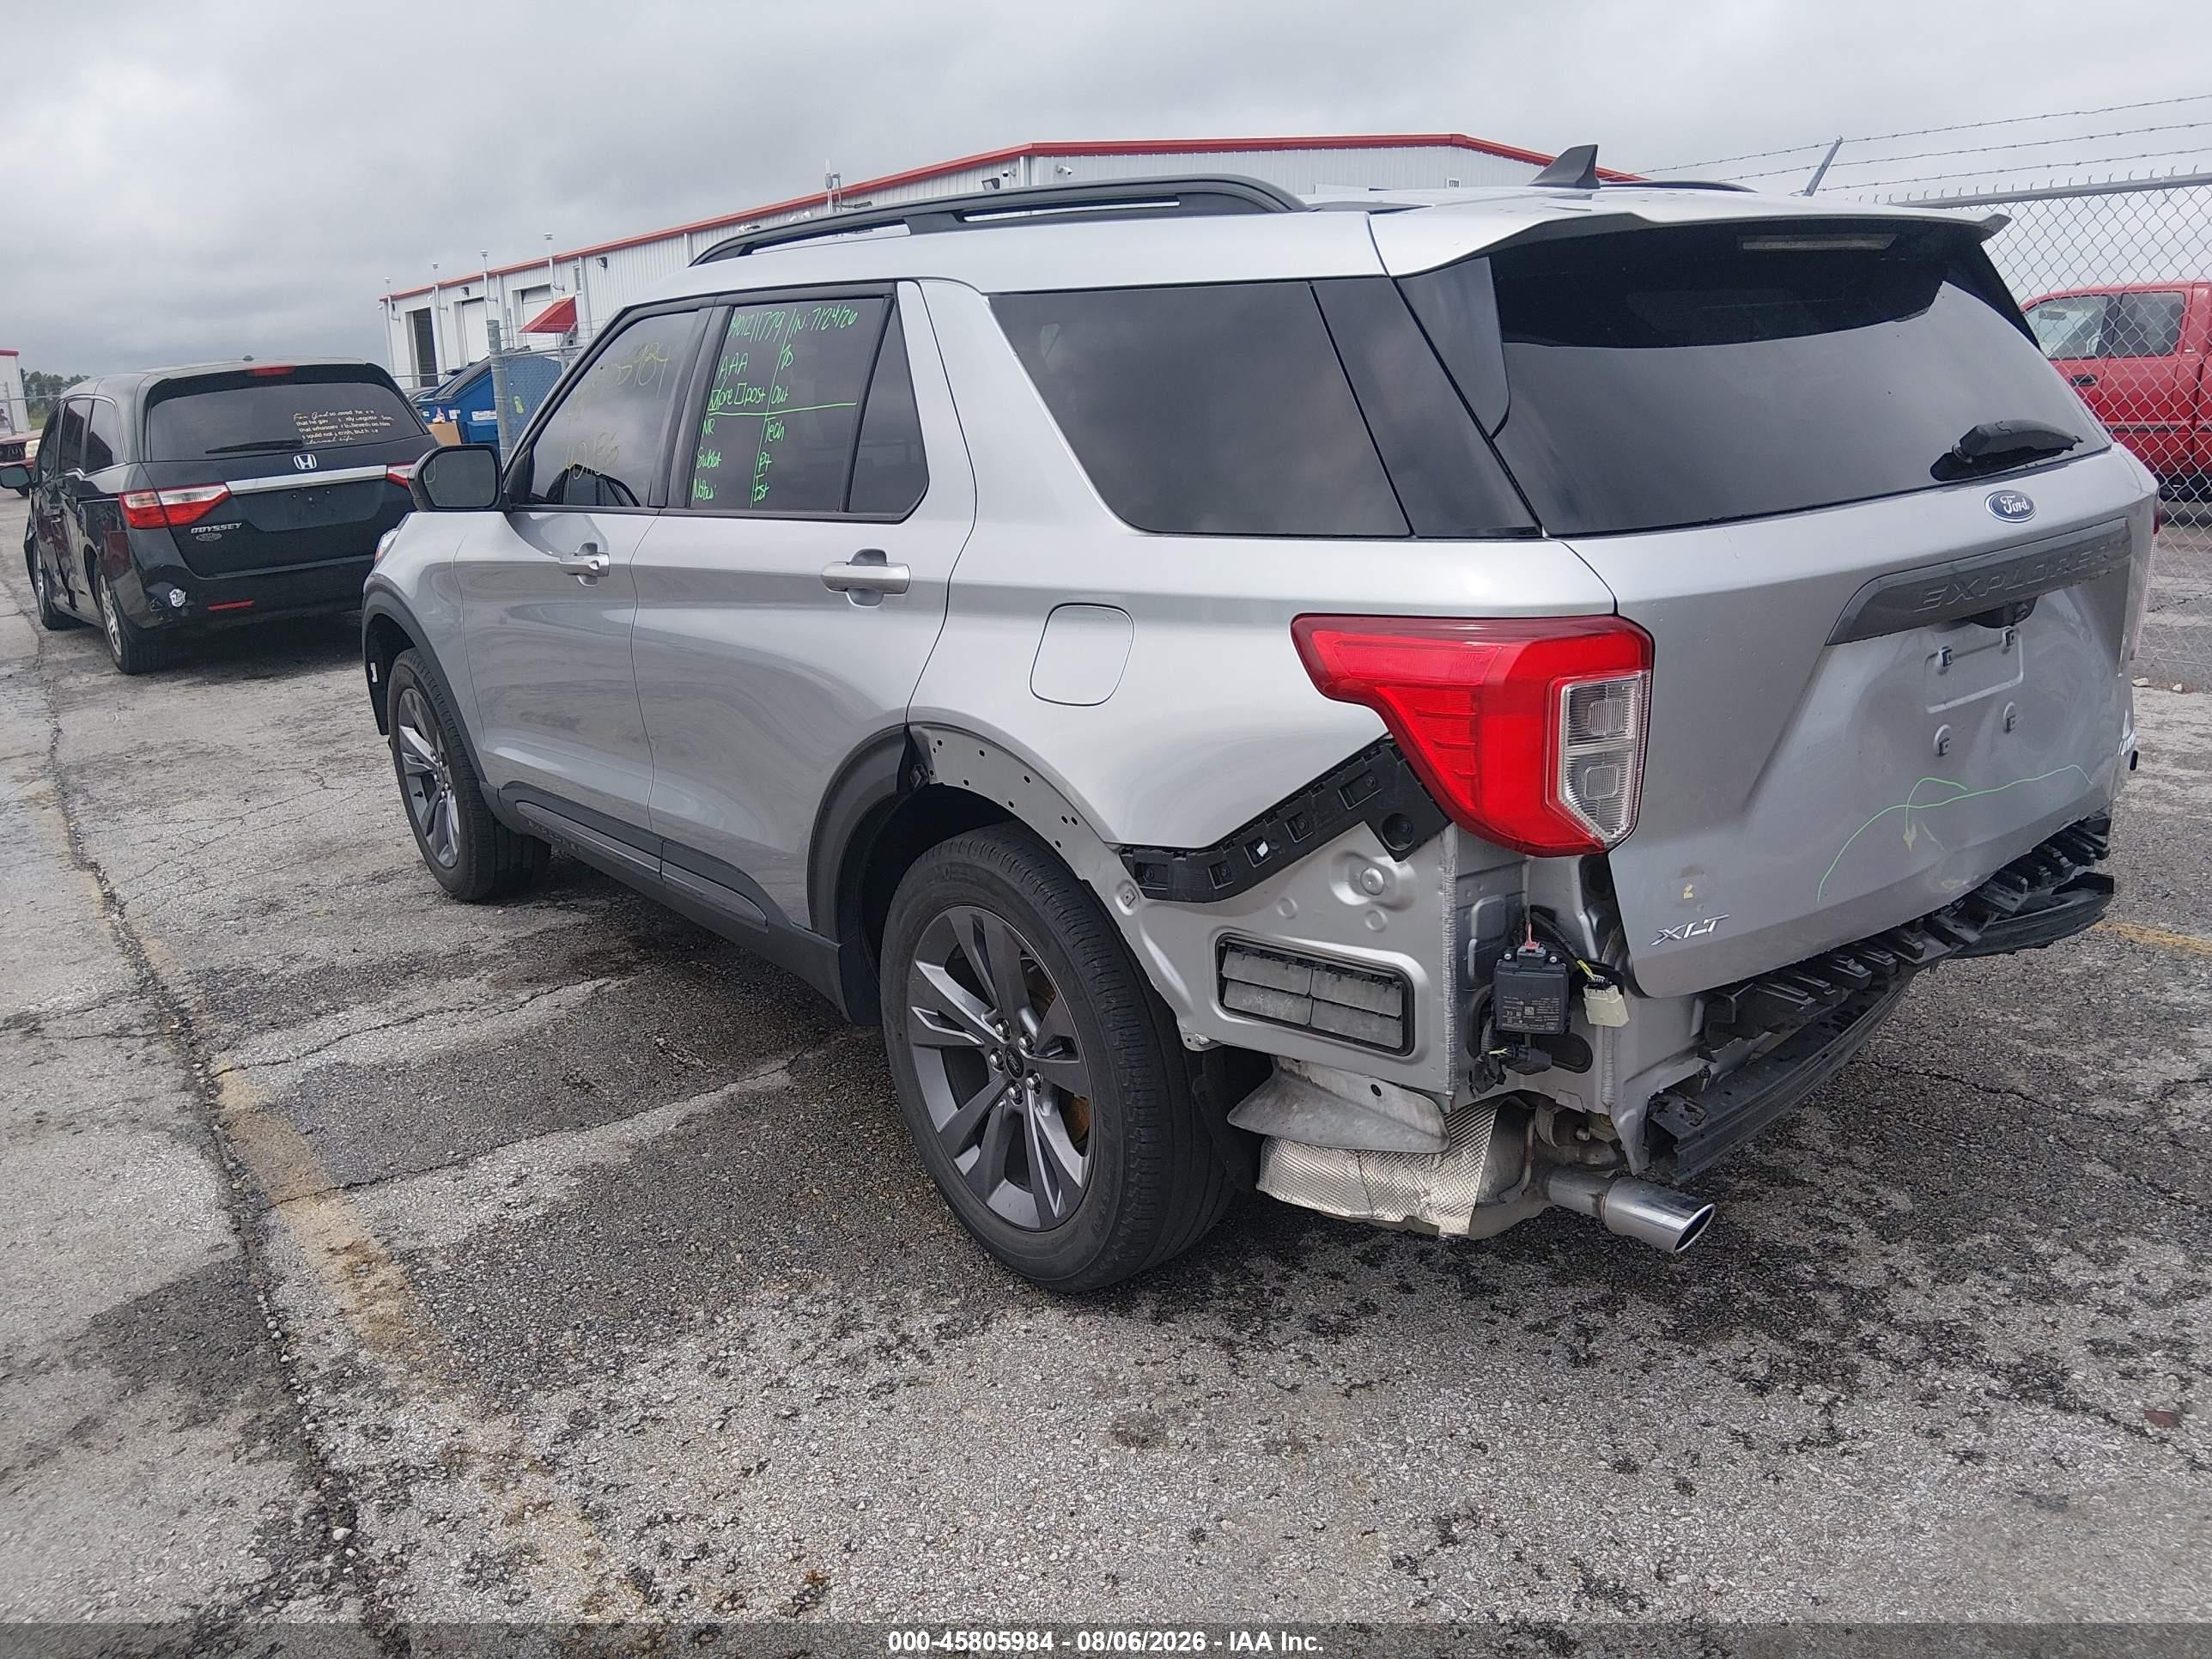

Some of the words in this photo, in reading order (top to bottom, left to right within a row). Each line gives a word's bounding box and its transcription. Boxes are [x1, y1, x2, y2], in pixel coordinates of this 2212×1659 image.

[718, 352, 748, 380] AAA
[744, 386, 766, 407] post
[764, 416, 785, 444] Tech
[1999, 495, 2030, 514] Ford
[191, 522, 242, 534] ODYSSEY
[1914, 544, 2109, 612] EXPLORER
[1649, 913, 1731, 946] XLT
